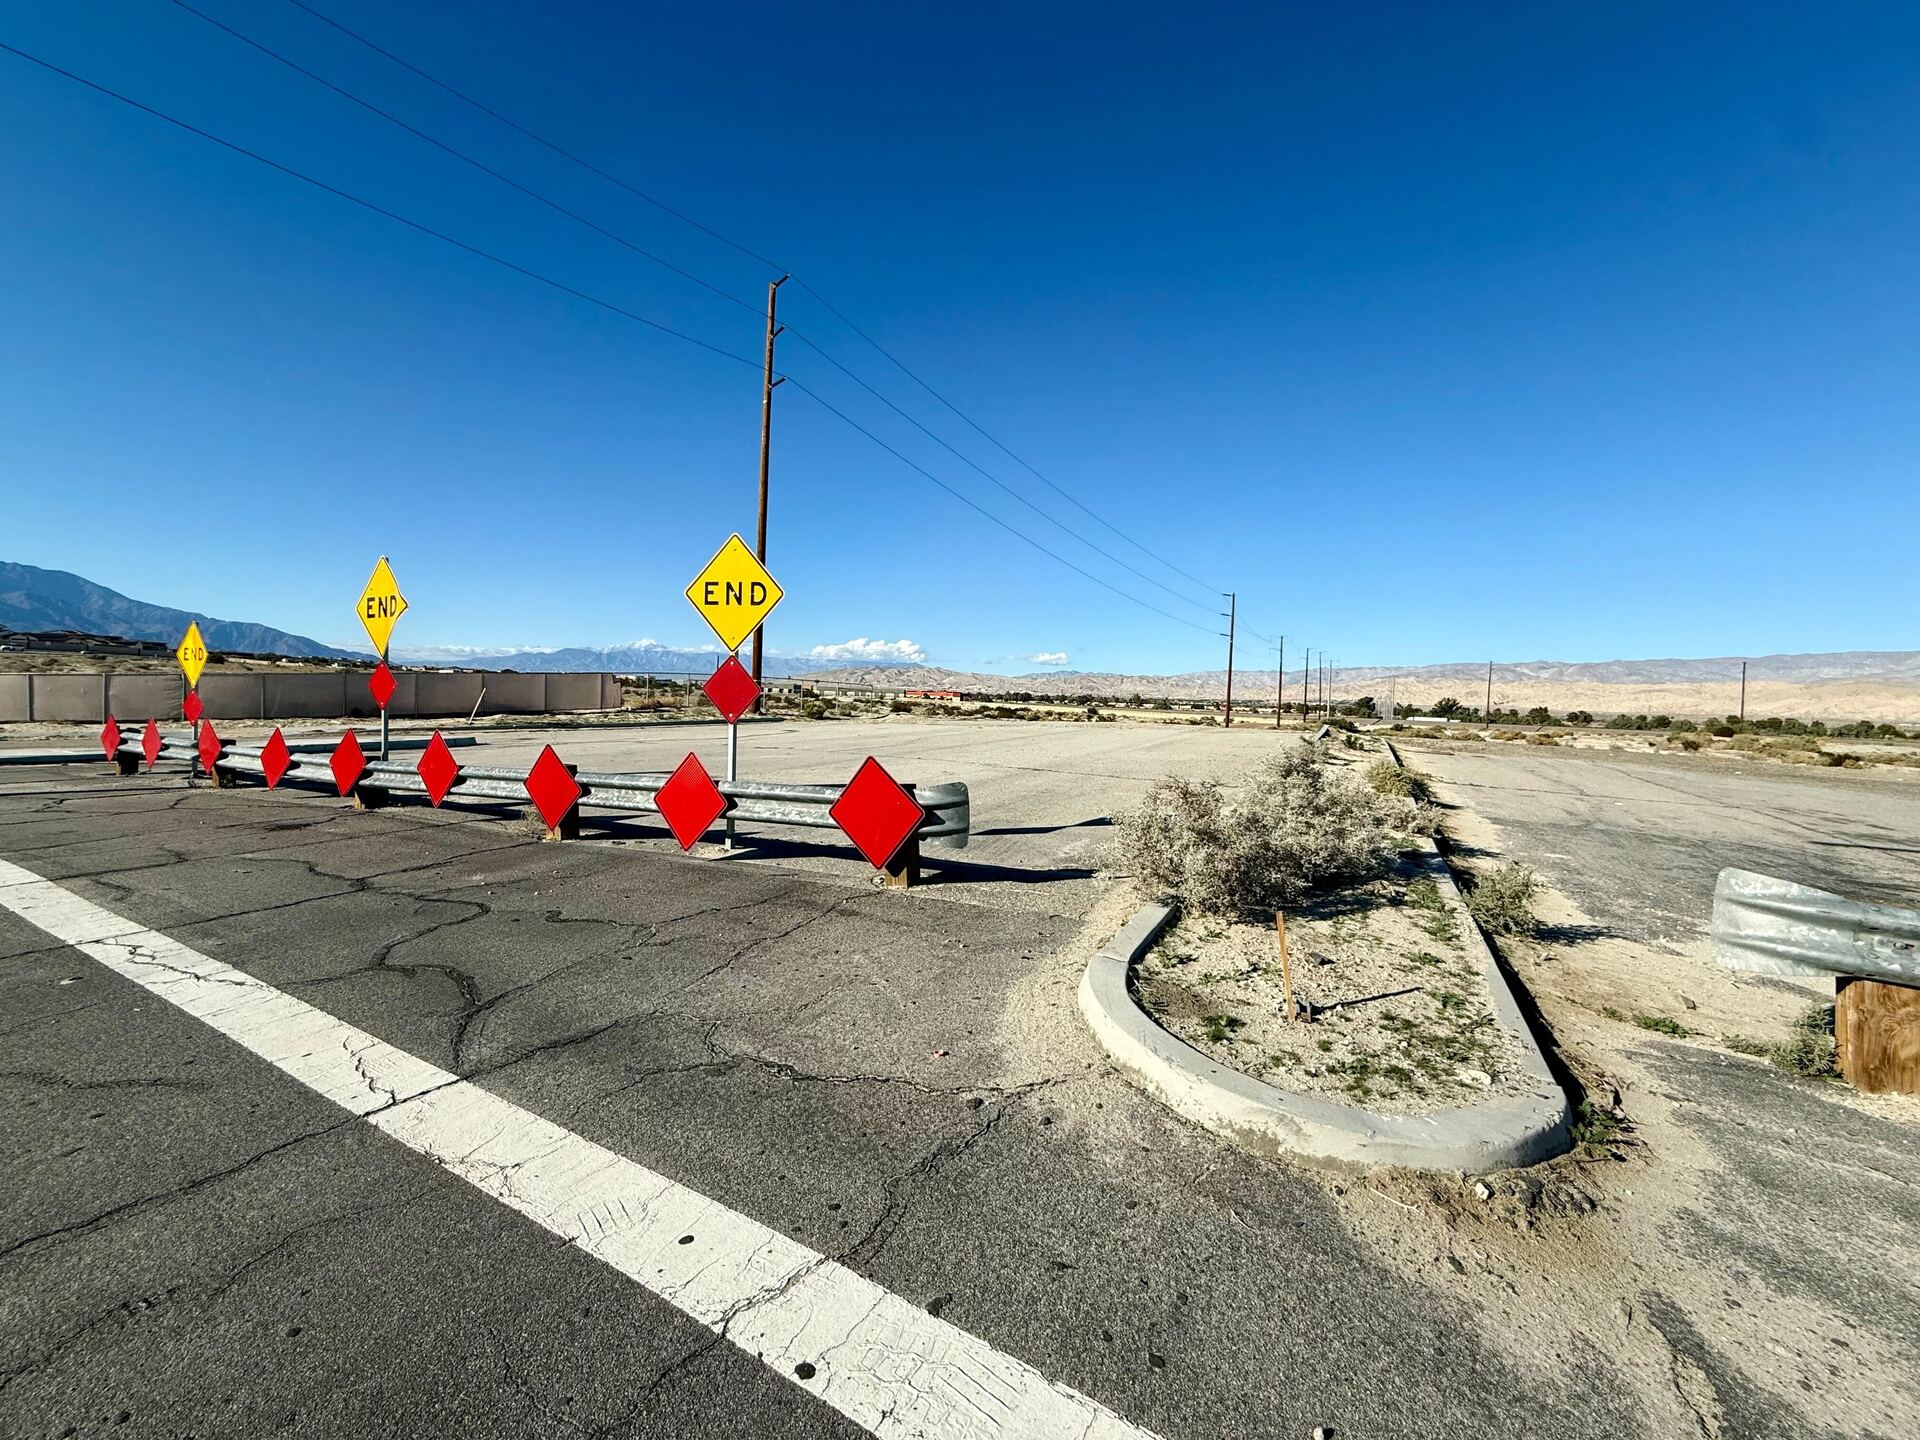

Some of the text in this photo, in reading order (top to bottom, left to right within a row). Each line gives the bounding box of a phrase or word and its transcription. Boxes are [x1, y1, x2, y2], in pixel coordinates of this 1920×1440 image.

[704, 581, 767, 606] END
[367, 595, 397, 619] END
[184, 647, 203, 661] END
